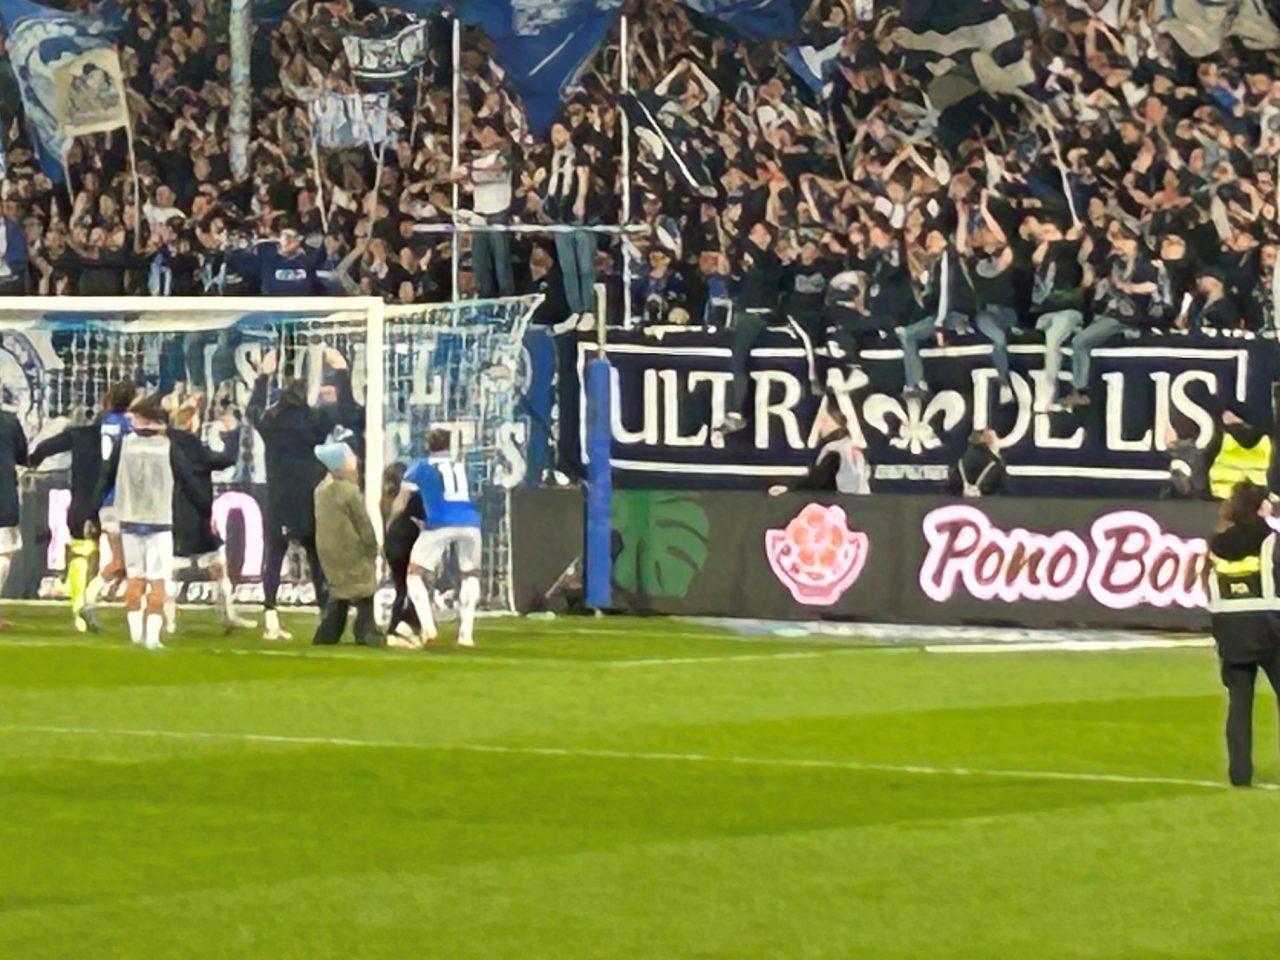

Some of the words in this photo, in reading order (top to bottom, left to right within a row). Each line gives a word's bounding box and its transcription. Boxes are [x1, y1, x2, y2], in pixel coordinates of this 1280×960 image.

[609, 365, 868, 449] ULTRA
[971, 368, 1085, 450] DE
[1102, 370, 1217, 451] LIS
[926, 510, 1084, 596] Pono
